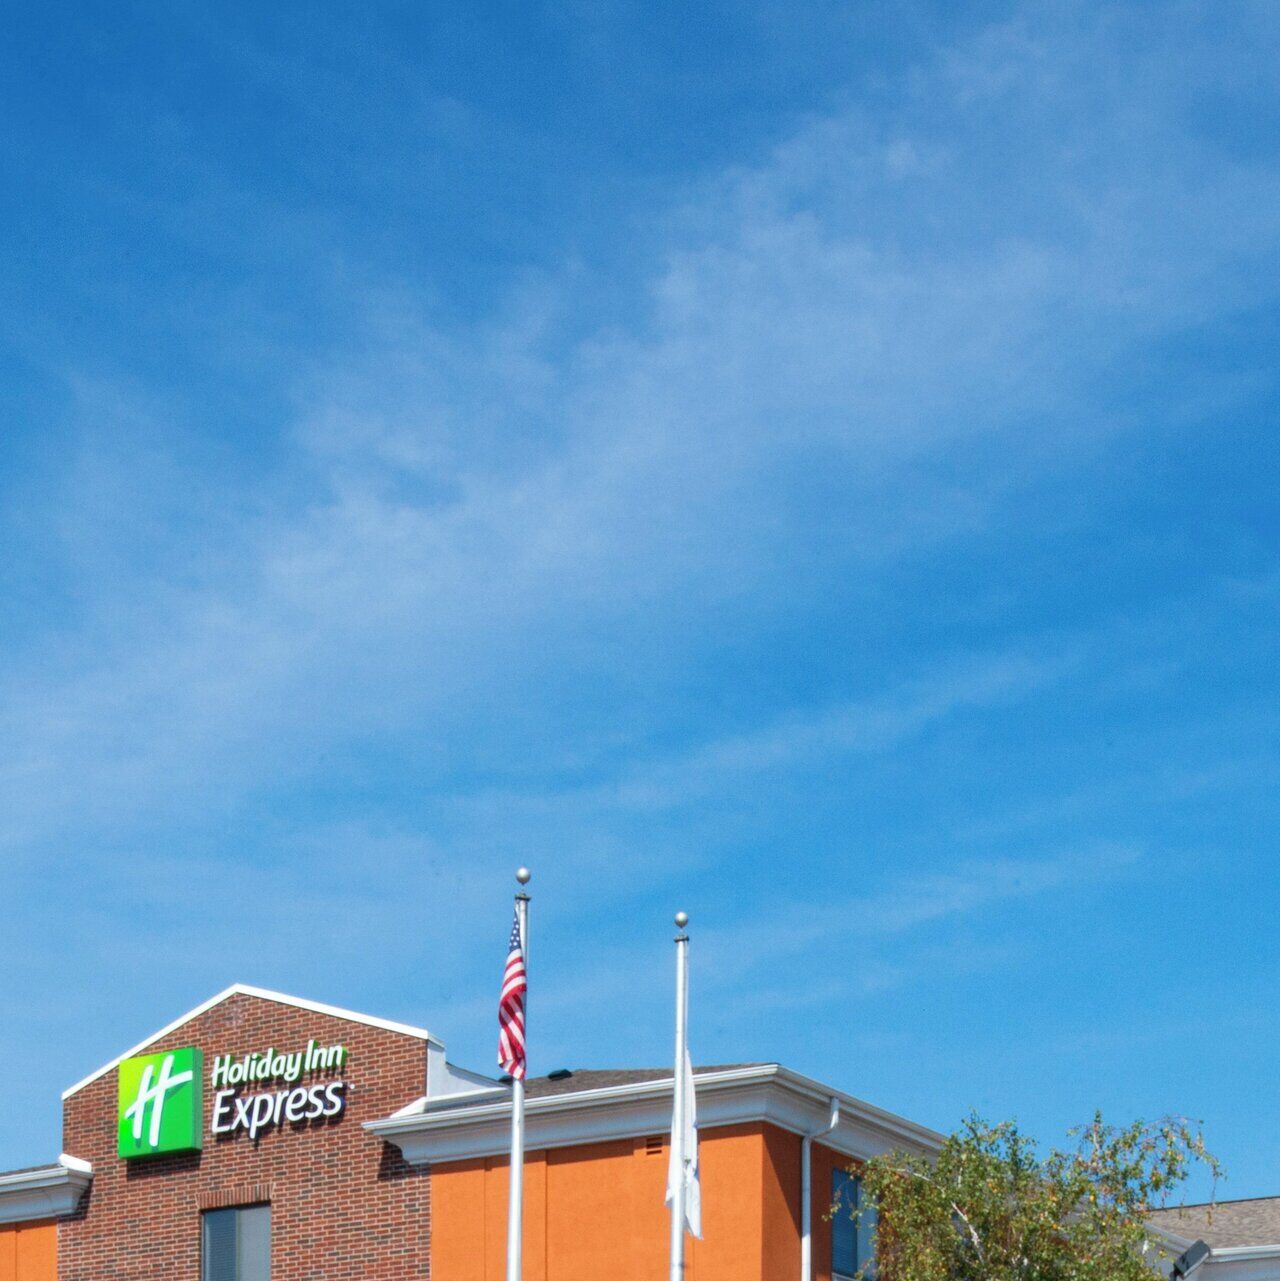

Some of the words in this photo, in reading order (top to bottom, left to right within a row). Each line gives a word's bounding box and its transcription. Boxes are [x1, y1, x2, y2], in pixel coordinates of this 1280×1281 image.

[211, 1047, 303, 1087] Holiday
[304, 1039, 344, 1072] Inn
[211, 1081, 344, 1139] Express
